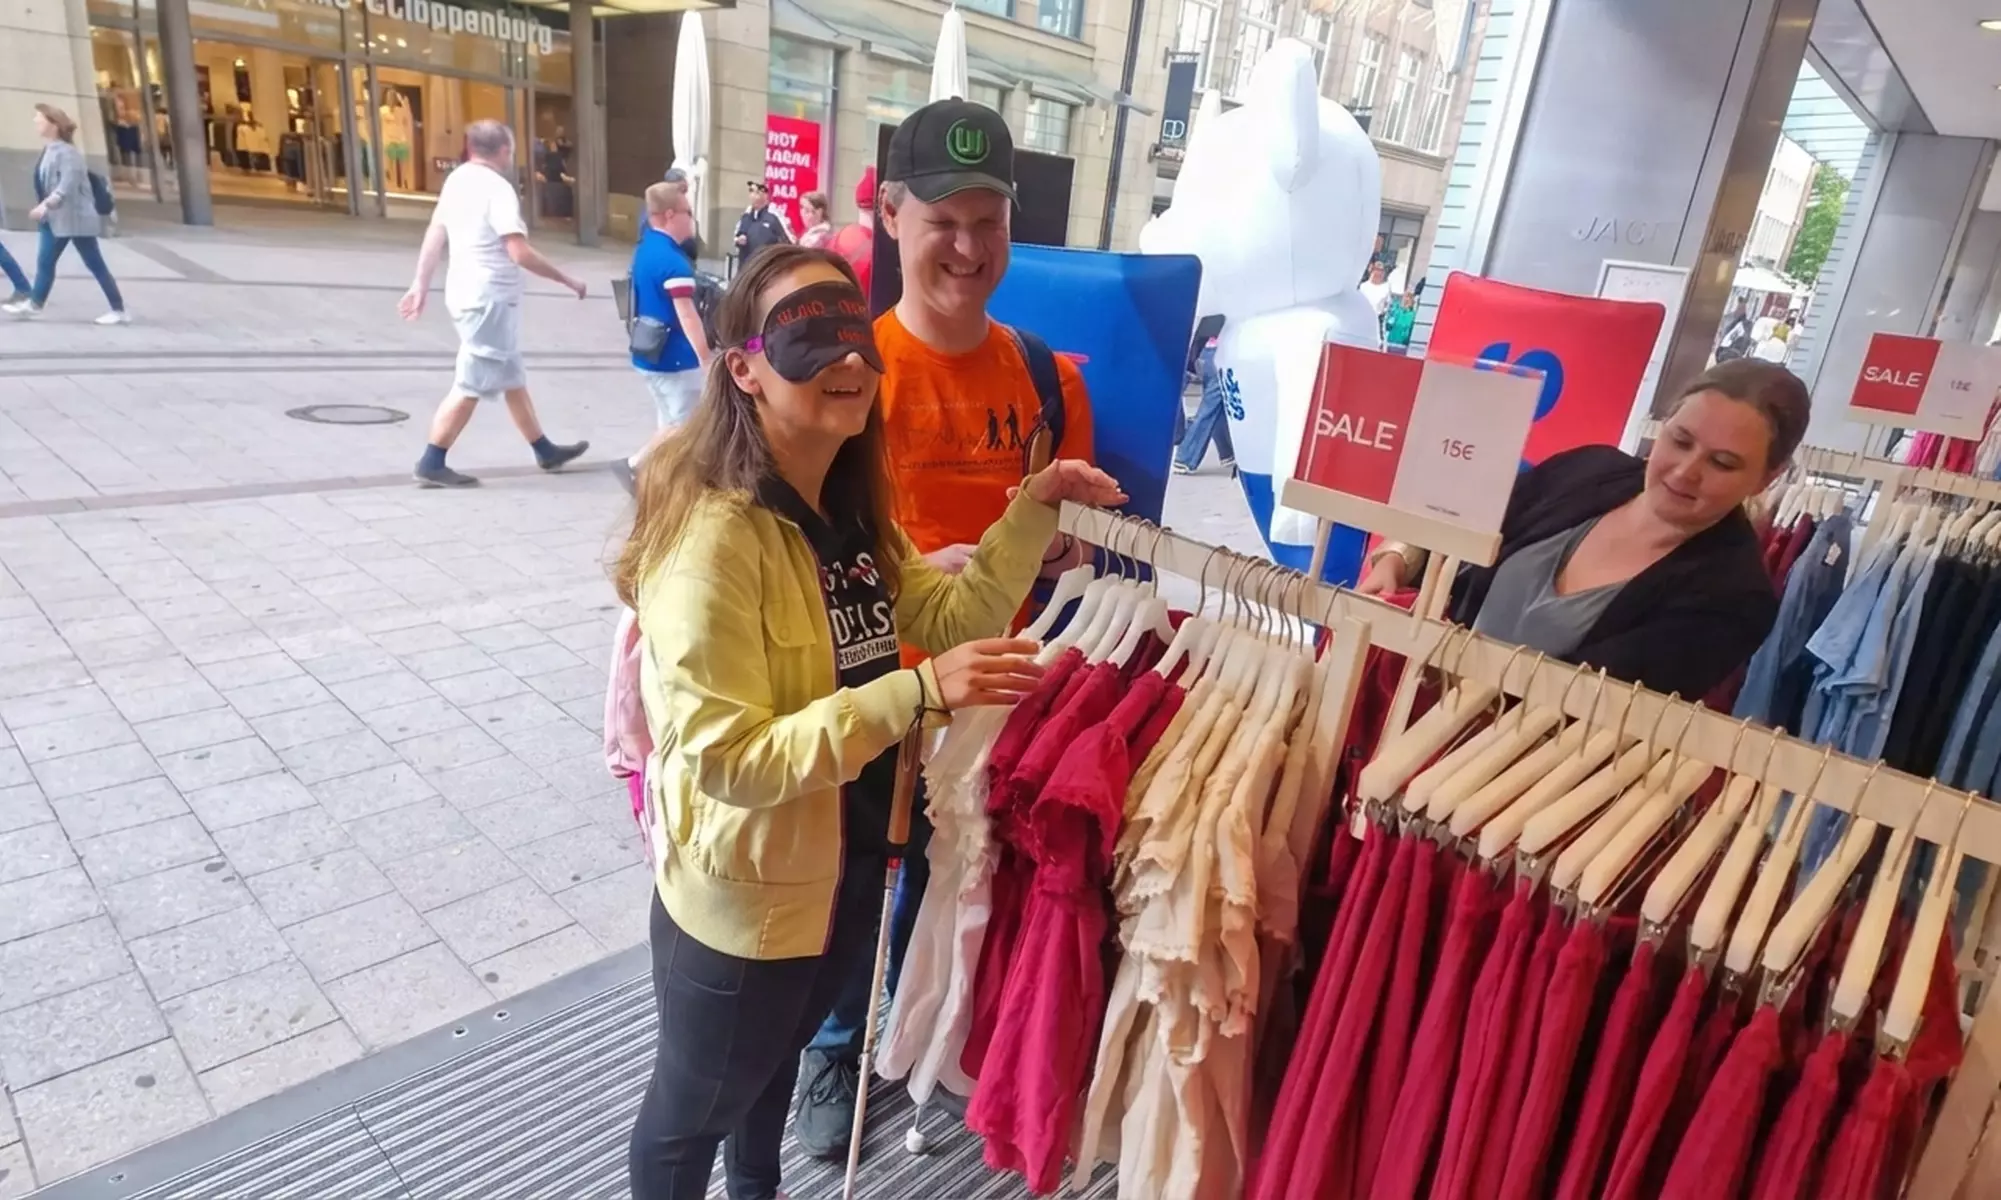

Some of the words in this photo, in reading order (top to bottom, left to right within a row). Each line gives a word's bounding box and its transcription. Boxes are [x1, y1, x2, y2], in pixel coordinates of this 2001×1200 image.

[1864, 366, 1923, 388] SALE
[1316, 409, 1398, 451] SALE
[1441, 438, 1475, 461] 15€
